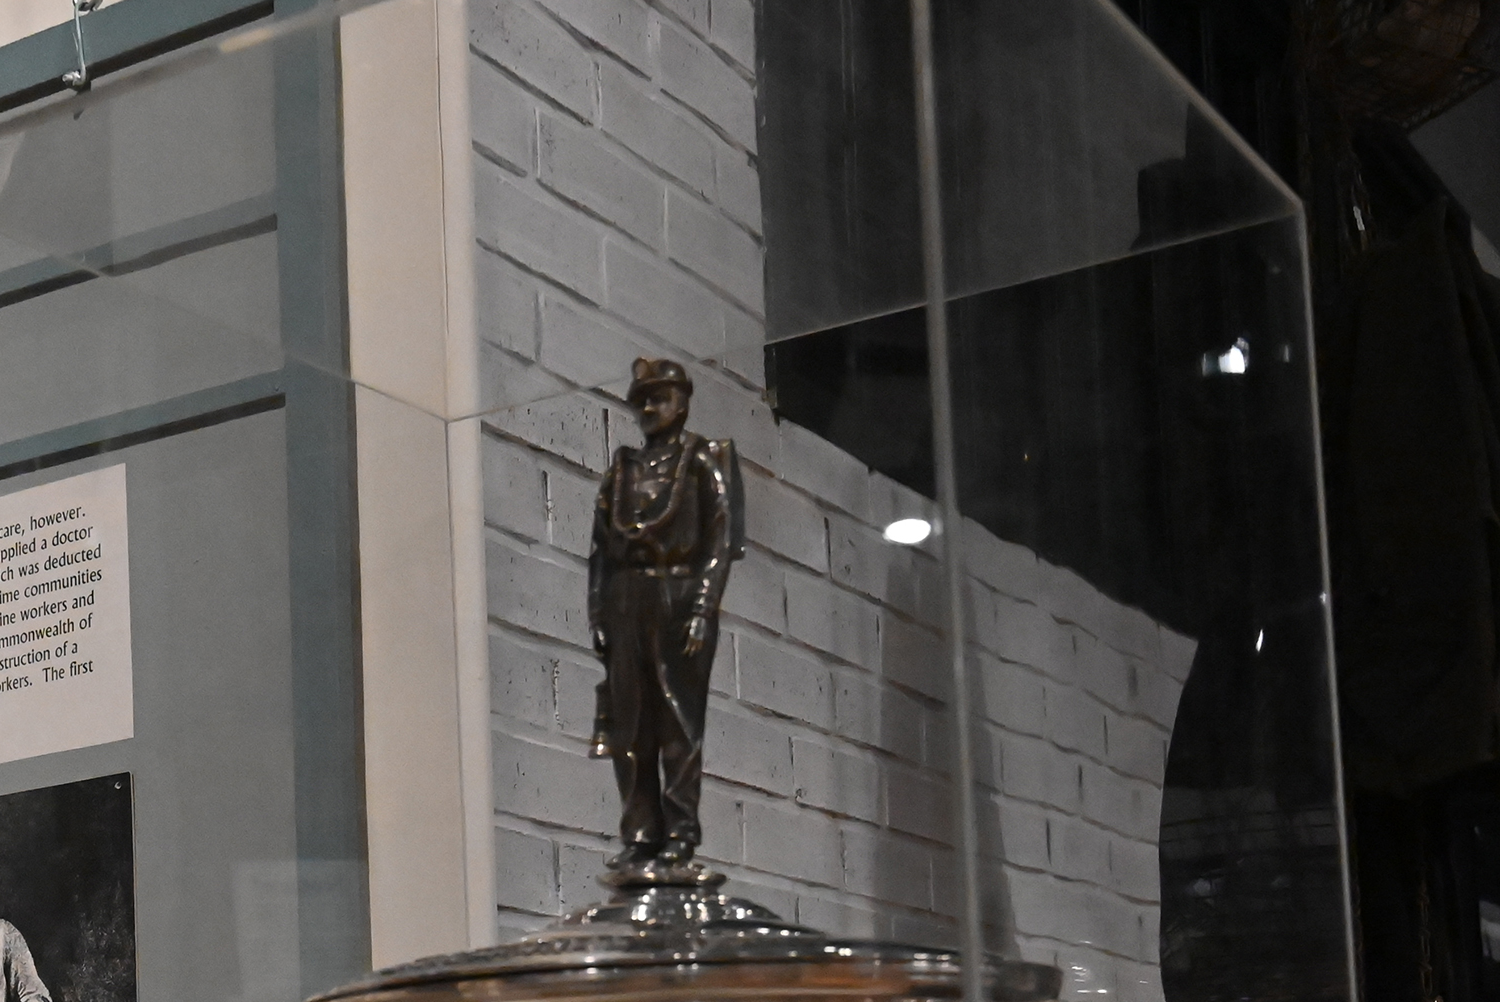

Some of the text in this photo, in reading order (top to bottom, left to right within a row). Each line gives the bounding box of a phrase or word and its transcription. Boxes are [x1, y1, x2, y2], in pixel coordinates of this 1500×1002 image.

[29, 506, 86, 531] however.
[40, 538, 47, 550] a
[51, 525, 93, 547] doctor
[17, 562, 40, 577] was
[43, 543, 101, 571] deducted
[23, 568, 102, 598] communities
[19, 599, 68, 621] workers
[71, 589, 95, 610] and
[78, 611, 93, 630] of
[54, 640, 69, 658] of
[71, 642, 78, 654] a
[41, 666, 65, 683] The
[69, 659, 94, 677] first
